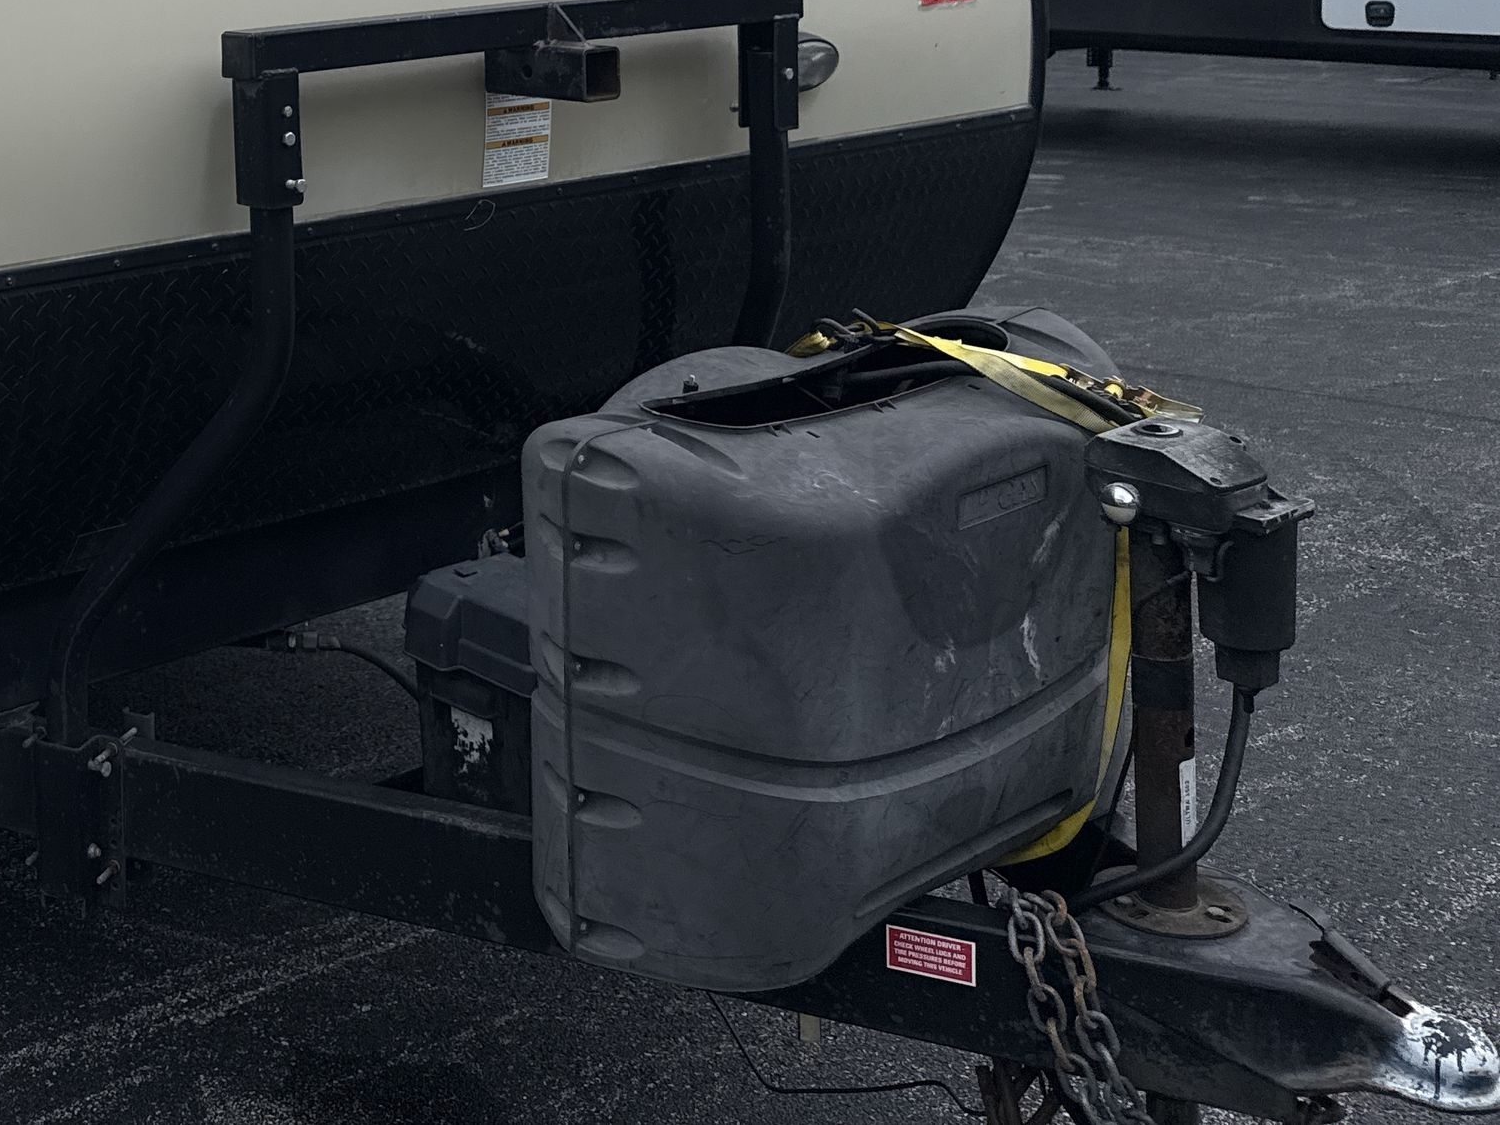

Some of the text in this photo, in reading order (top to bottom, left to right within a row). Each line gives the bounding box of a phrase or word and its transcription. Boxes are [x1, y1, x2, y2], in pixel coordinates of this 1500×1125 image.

[893, 940, 966, 961] CHECK WHEEL LUGS AND
[899, 933, 961, 951] ATTENTION DRIVER
[894, 948, 966, 969] TIRE PRESSURES BEFORE
[898, 956, 963, 975] MOVING THIS VEHICLE
